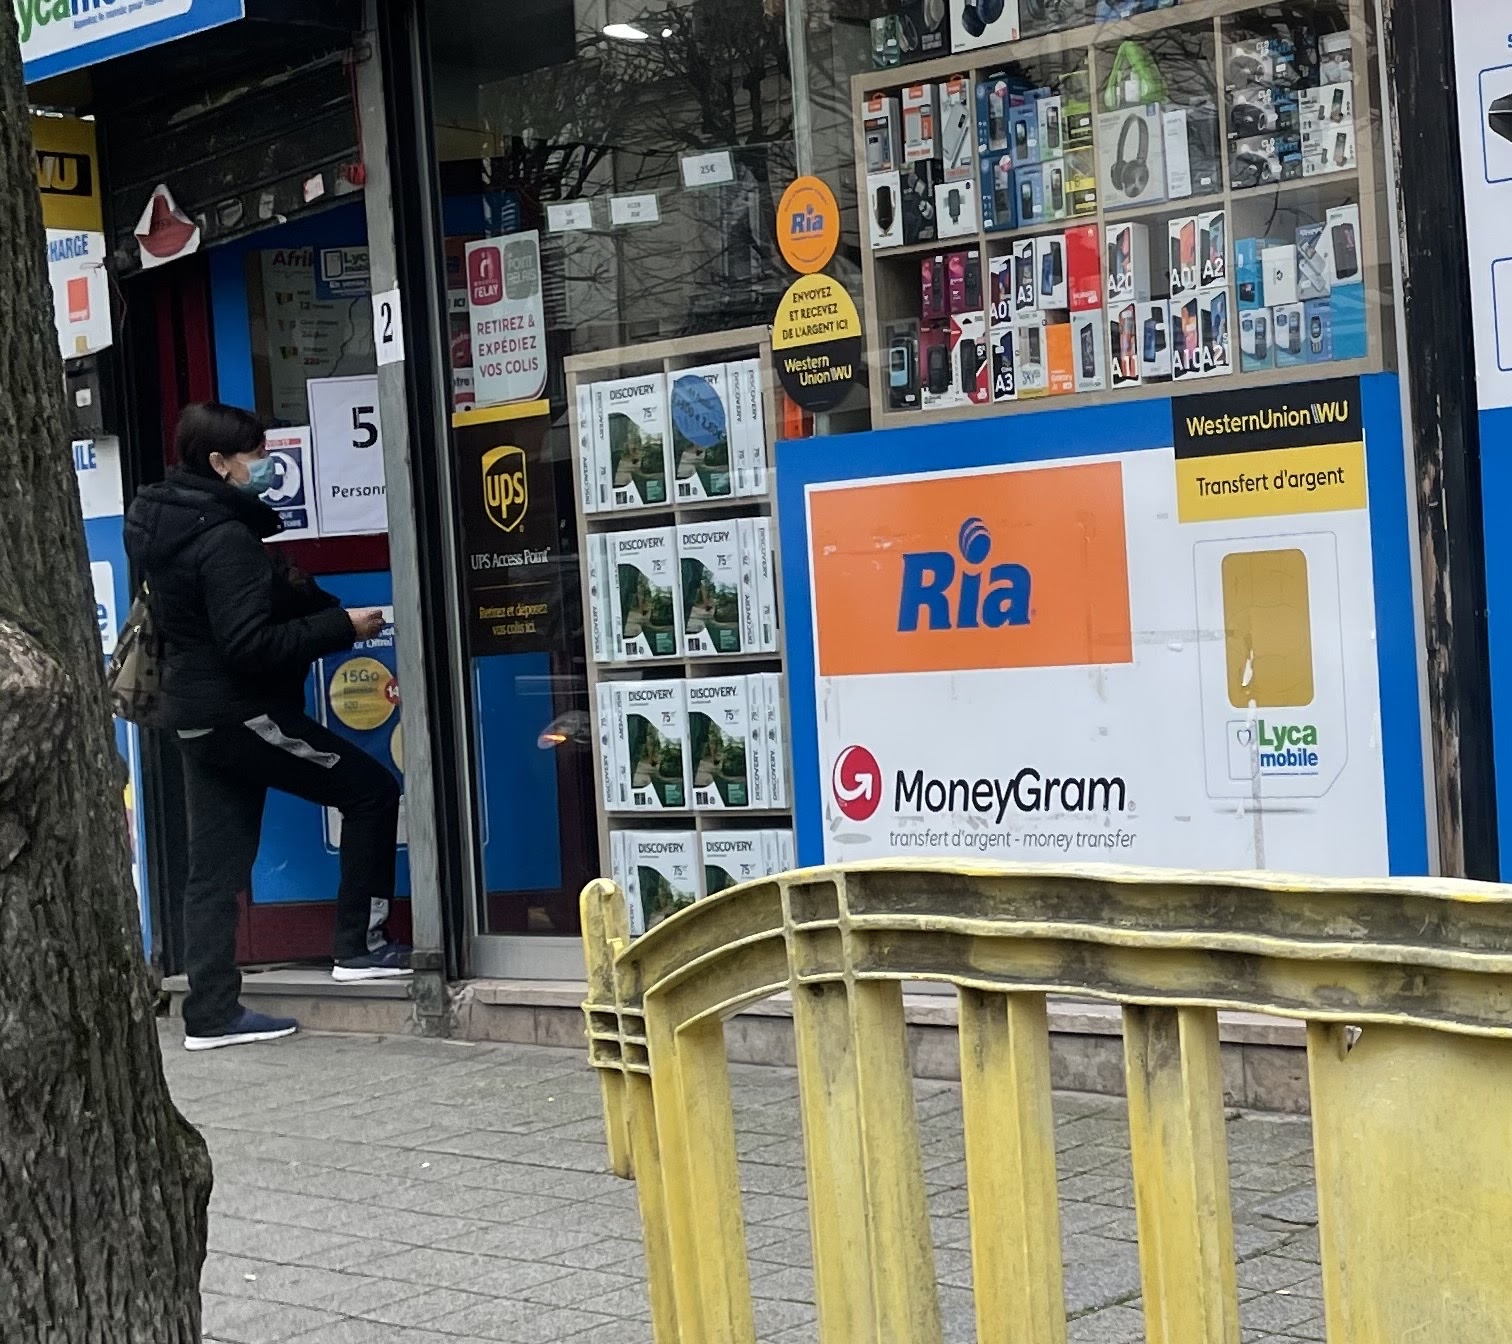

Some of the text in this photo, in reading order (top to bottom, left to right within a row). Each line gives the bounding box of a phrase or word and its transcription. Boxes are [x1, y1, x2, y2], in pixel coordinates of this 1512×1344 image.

[791, 204, 823, 234] Ria
[793, 286, 832, 304] ENVOYEZ
[381, 302, 394, 344] 2
[790, 303, 838, 322] ET RECEVEZ
[477, 314, 535, 336] RETIREZ &
[782, 319, 848, 340] DE L'ARGENT ICI
[478, 336, 537, 357] EXPÉDIEZ
[479, 357, 539, 379] VOS COLIS
[784, 354, 830, 374] Western
[800, 368, 831, 387] Union
[610, 383, 655, 401] DISCOVERY
[351, 405, 378, 449] 5
[1186, 405, 1311, 437] WesternUnion
[1196, 467, 1345, 497] Transfert d'argent
[487, 471, 524, 519] ups
[619, 536, 665, 552] DISCOVERY
[683, 531, 730, 545] DISCOVERY
[471, 553, 490, 570] UPS
[492, 550, 523, 567] Access
[896, 516, 1033, 632] Ria
[628, 688, 674, 702] DISCOVERY
[690, 686, 738, 699] DISCOVERY
[1258, 719, 1318, 752] Lyca
[1260, 747, 1319, 767] mobile
[894, 767, 1126, 825] MoneyGram
[639, 842, 684, 854] DISCOVERY
[706, 840, 752, 852] DISCOVERY
[890, 829, 1137, 853] transfert d'argent money transfer
